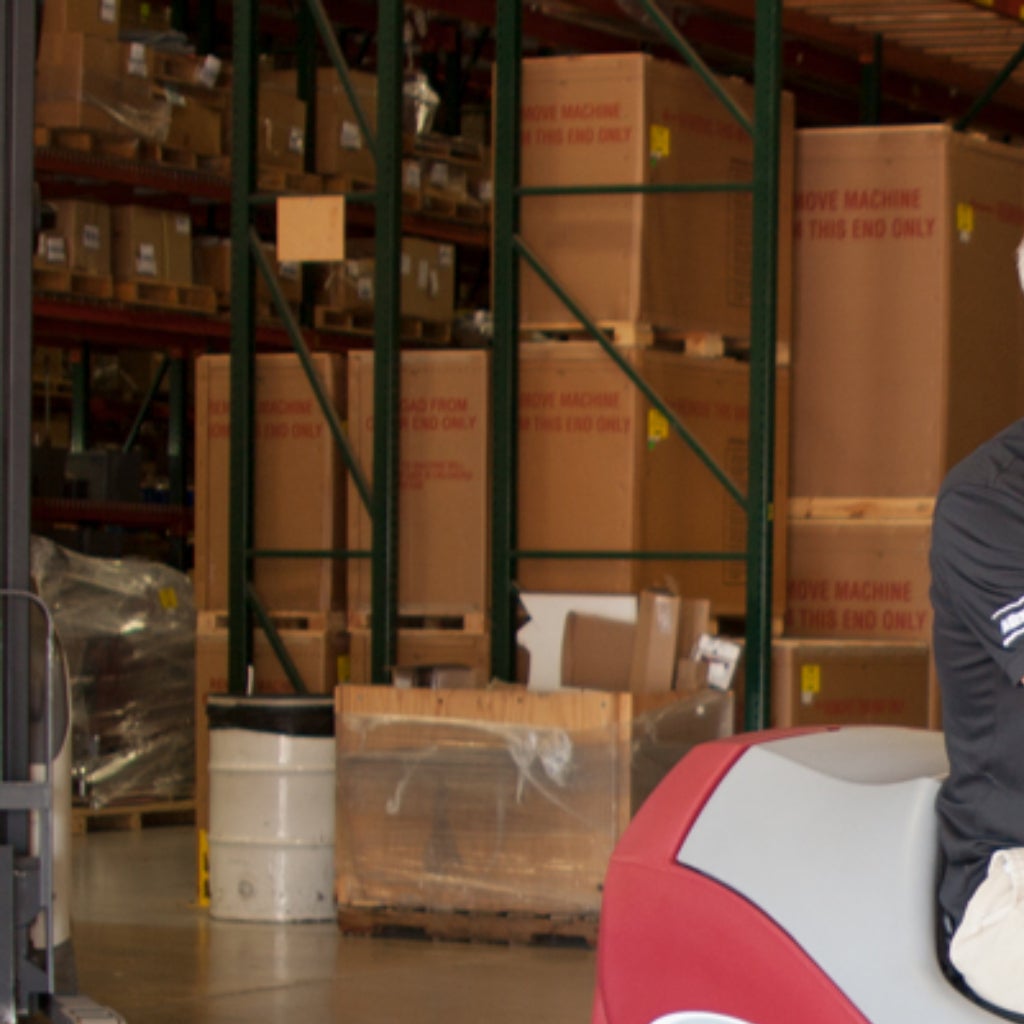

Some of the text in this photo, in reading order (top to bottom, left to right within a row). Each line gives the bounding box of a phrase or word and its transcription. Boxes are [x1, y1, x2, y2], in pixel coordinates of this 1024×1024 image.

[561, 102, 620, 119] MACHINE
[536, 127, 563, 145] THIS
[568, 127, 594, 144] END
[598, 126, 632, 144] ONLY
[845, 188, 920, 209] MACHINE
[809, 218, 846, 240] THIS
[851, 218, 886, 239] END
[891, 217, 935, 238] ONLY
[560, 391, 619, 408] MACHINE
[412, 416, 439, 432] END
[442, 415, 477, 432] ONLY
[565, 416, 592, 433] END
[596, 416, 631, 434] ONLY
[835, 581, 911, 602] MACHINE
[800, 609, 838, 630] THIS
[843, 609, 878, 631] END
[882, 609, 927, 631] ONLY
